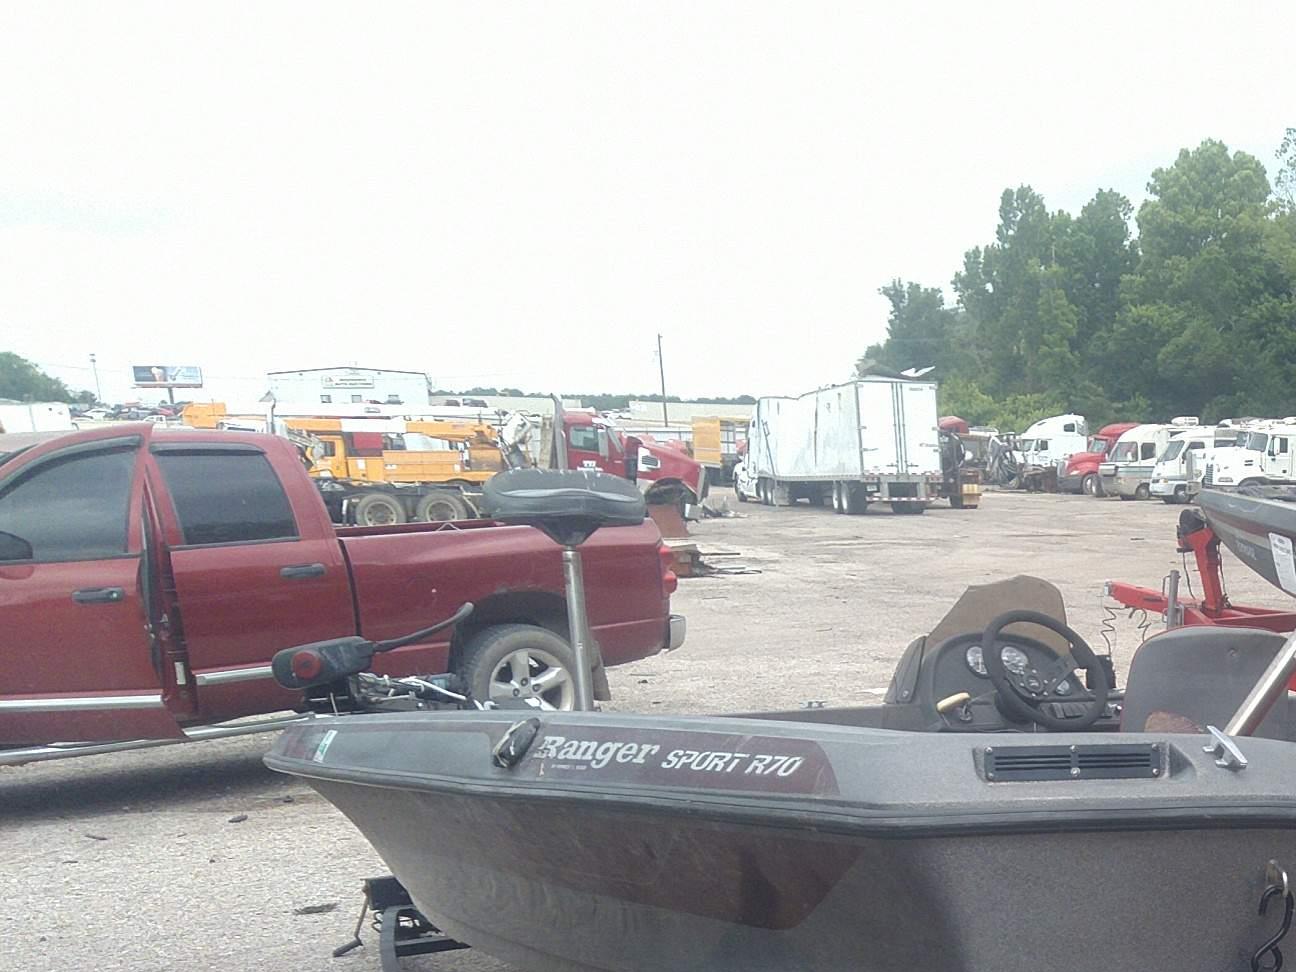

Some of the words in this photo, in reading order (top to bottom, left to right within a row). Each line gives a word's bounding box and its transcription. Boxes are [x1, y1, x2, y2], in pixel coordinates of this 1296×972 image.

[534, 735, 661, 769] Ranger
[661, 749, 750, 773] SPORT
[744, 756, 804, 777] R70
